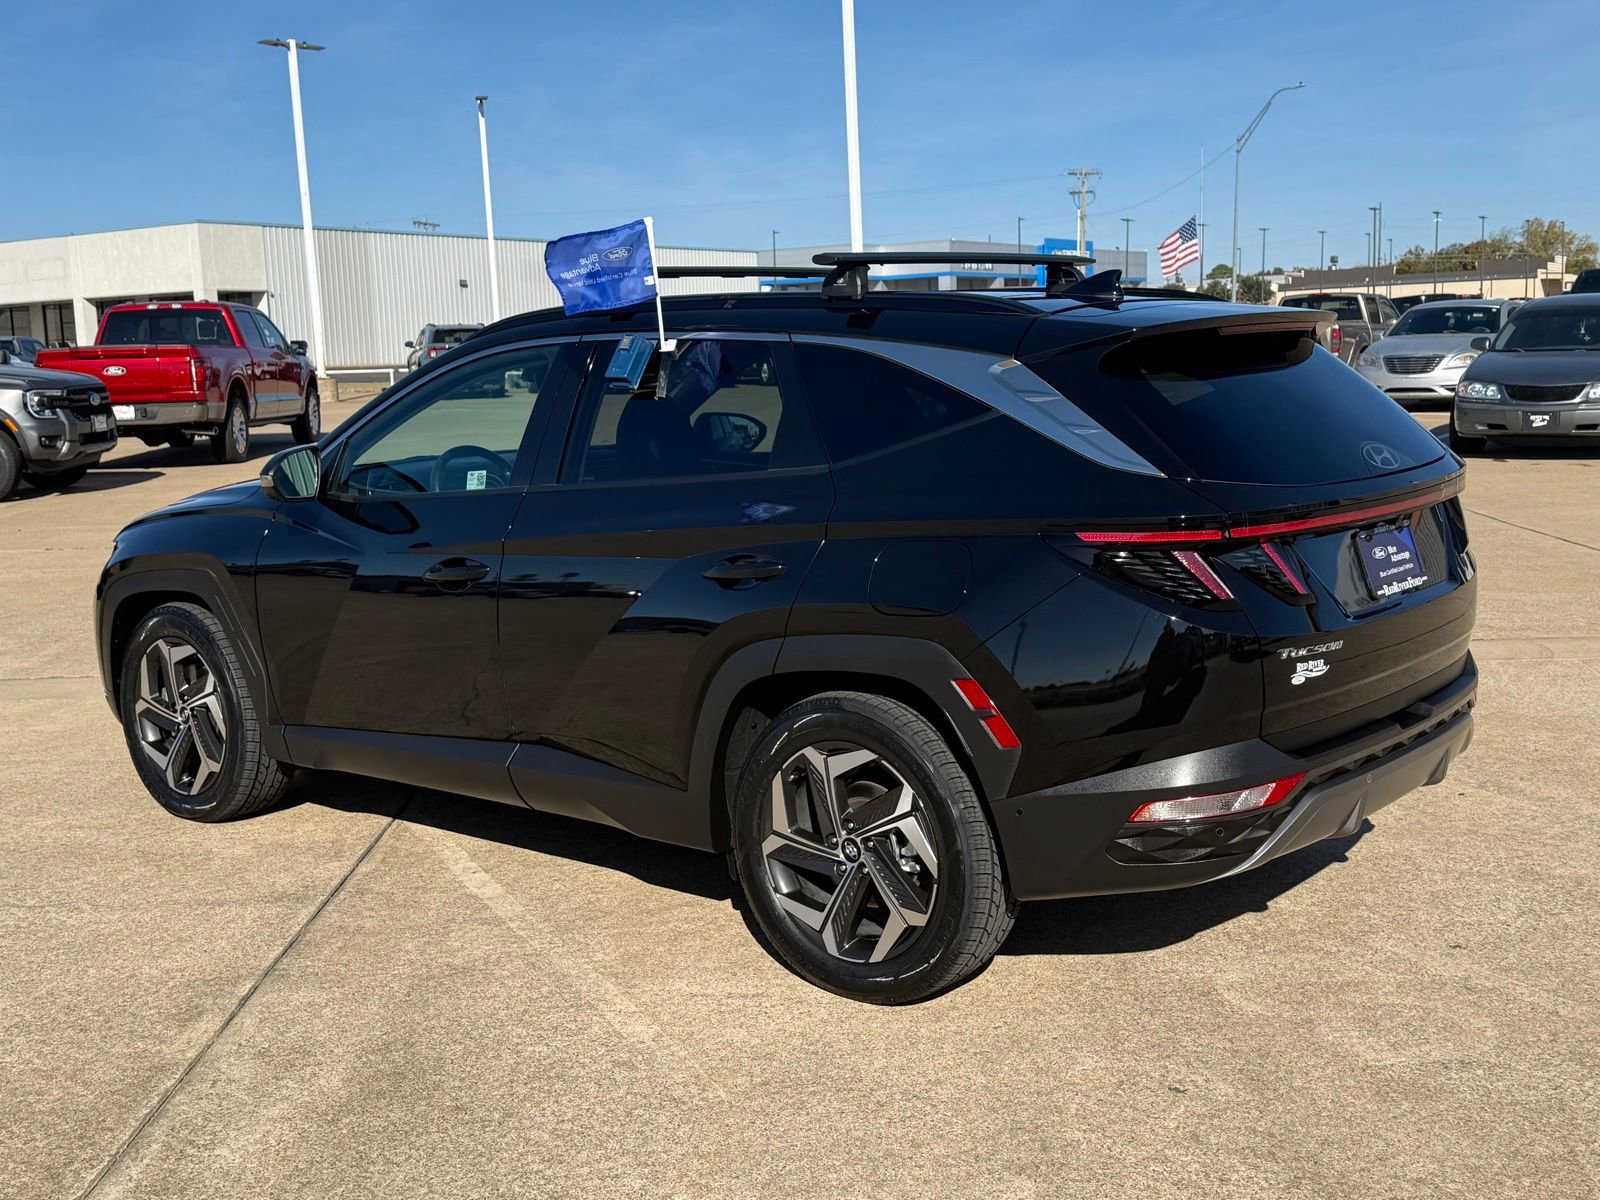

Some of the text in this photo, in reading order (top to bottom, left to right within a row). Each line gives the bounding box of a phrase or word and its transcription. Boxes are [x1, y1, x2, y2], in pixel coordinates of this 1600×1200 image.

[1277, 640, 1343, 659] TUCSON
[1296, 662, 1309, 672] RED
[1308, 659, 1325, 671] RIVER
